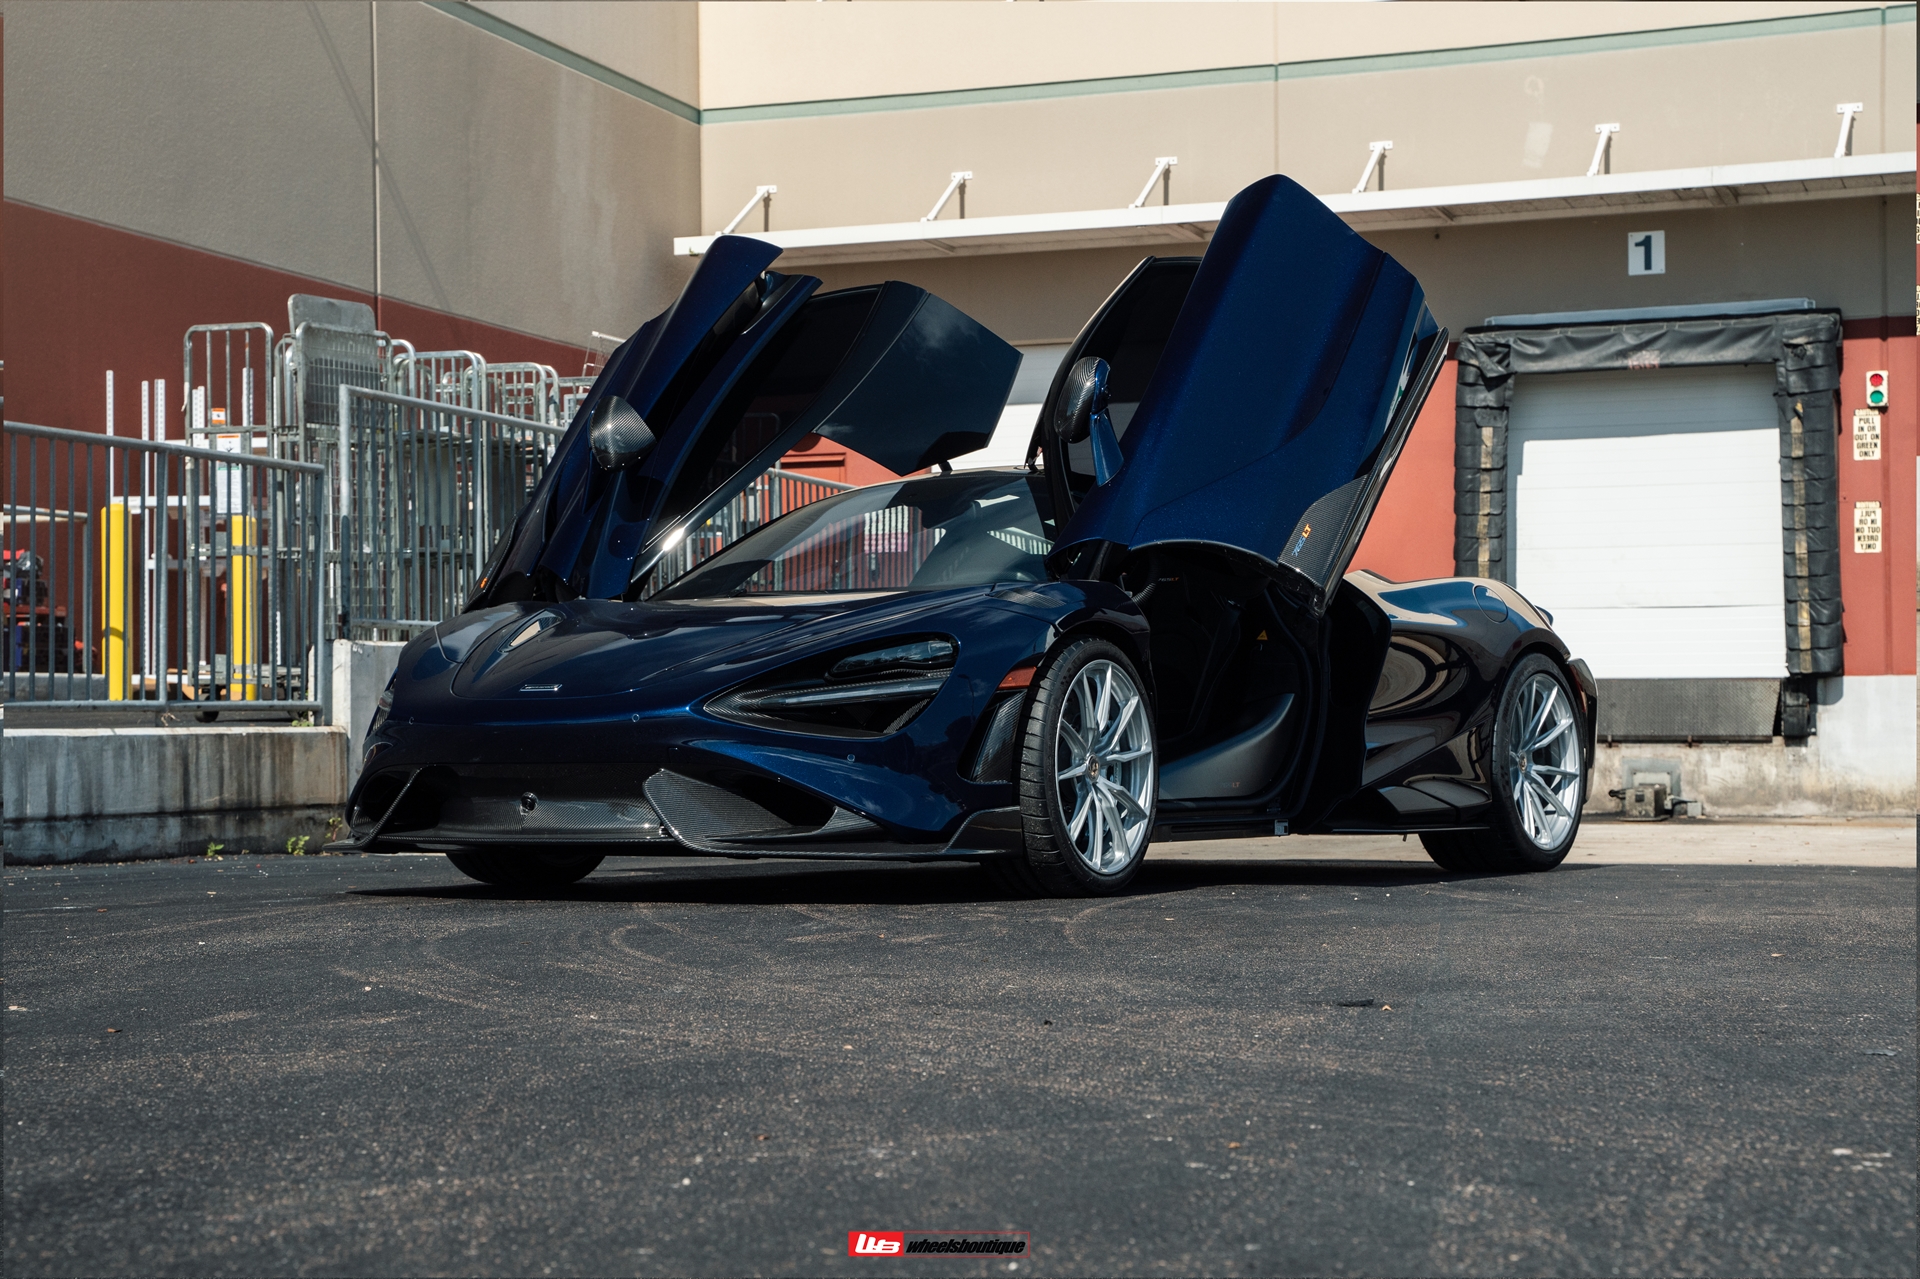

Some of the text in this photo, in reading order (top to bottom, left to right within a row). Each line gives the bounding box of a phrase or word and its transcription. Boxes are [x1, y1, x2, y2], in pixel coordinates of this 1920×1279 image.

[1634, 234, 1652, 271] 1
[1854, 433, 1868, 441] OUT
[1291, 523, 1312, 557] 765LT
